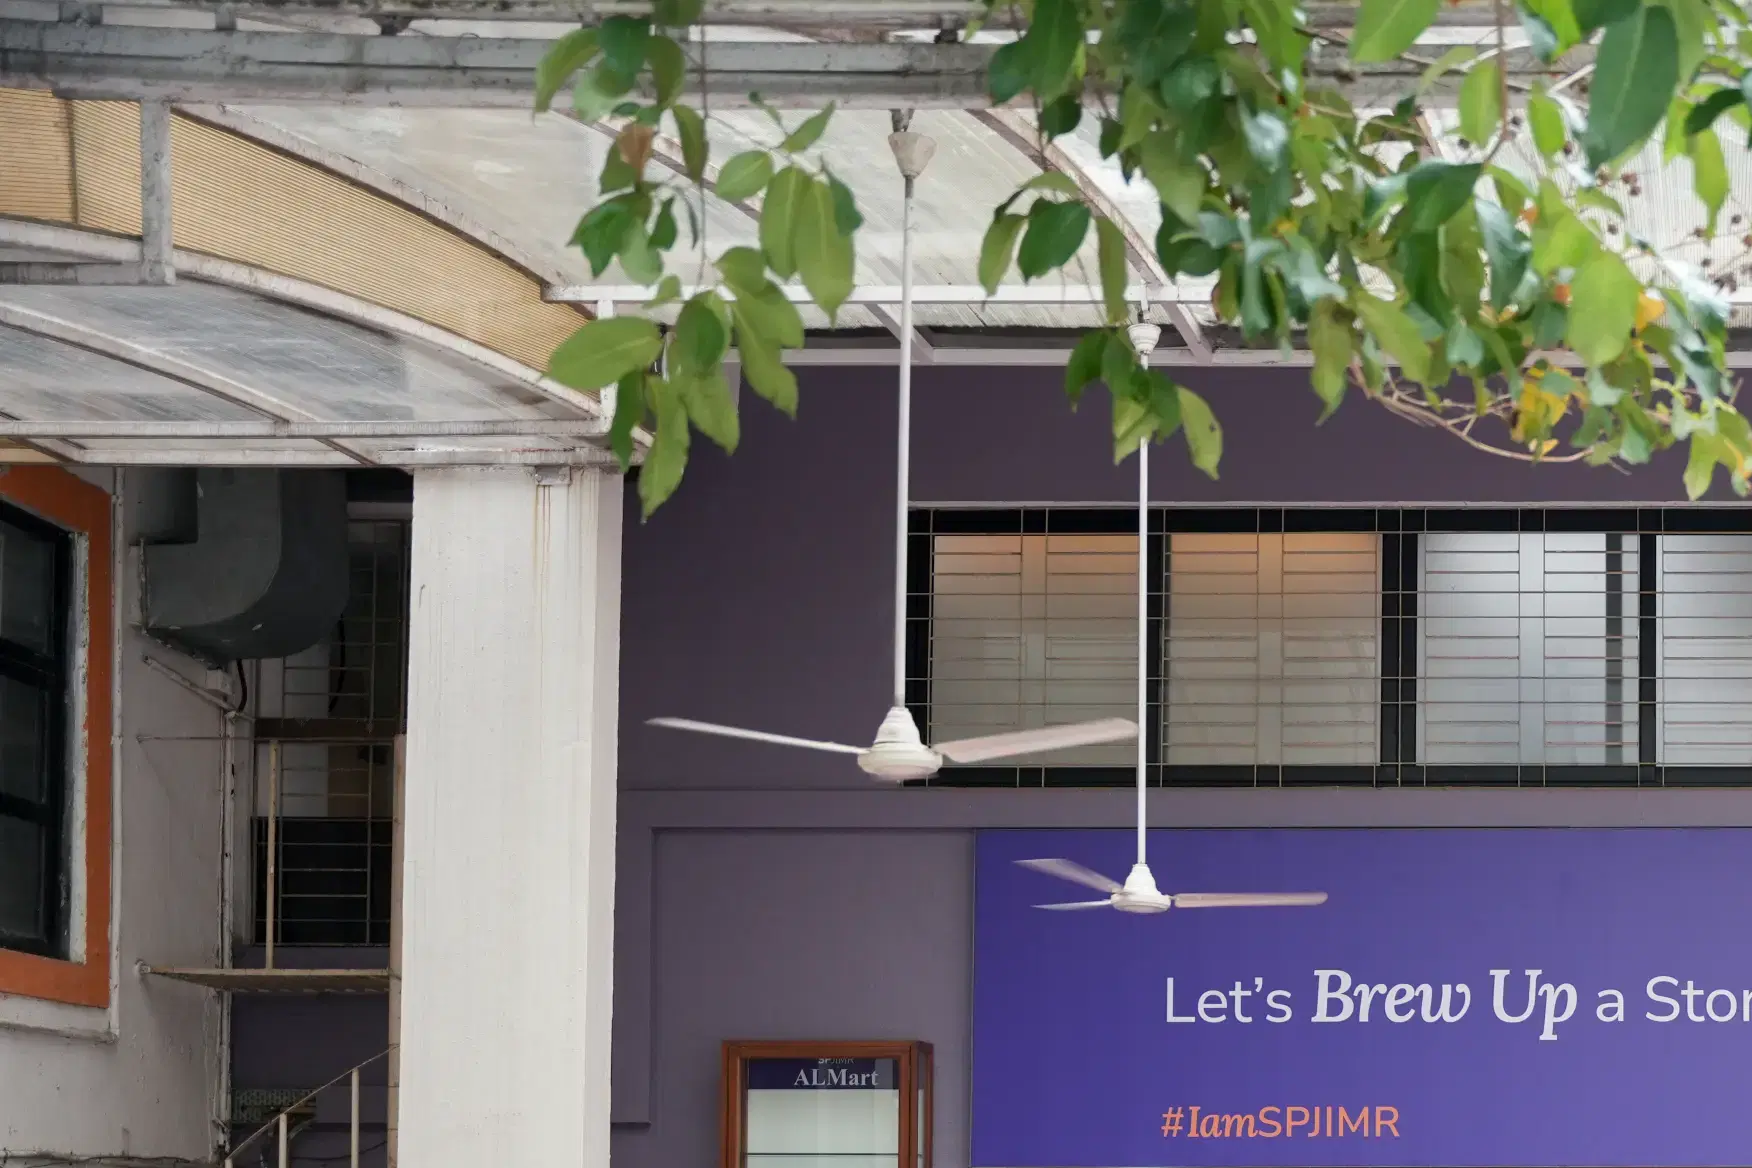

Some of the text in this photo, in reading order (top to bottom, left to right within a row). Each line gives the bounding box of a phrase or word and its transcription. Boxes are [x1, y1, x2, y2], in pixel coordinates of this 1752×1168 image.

[1165, 976, 1293, 1024] Let's
[1310, 968, 1471, 1023] Brew
[1489, 968, 1578, 1040] Up
[1595, 990, 1626, 1023] a
[794, 1068, 879, 1086] ALMart
[1161, 1104, 1400, 1140] #IamSPJIMR
